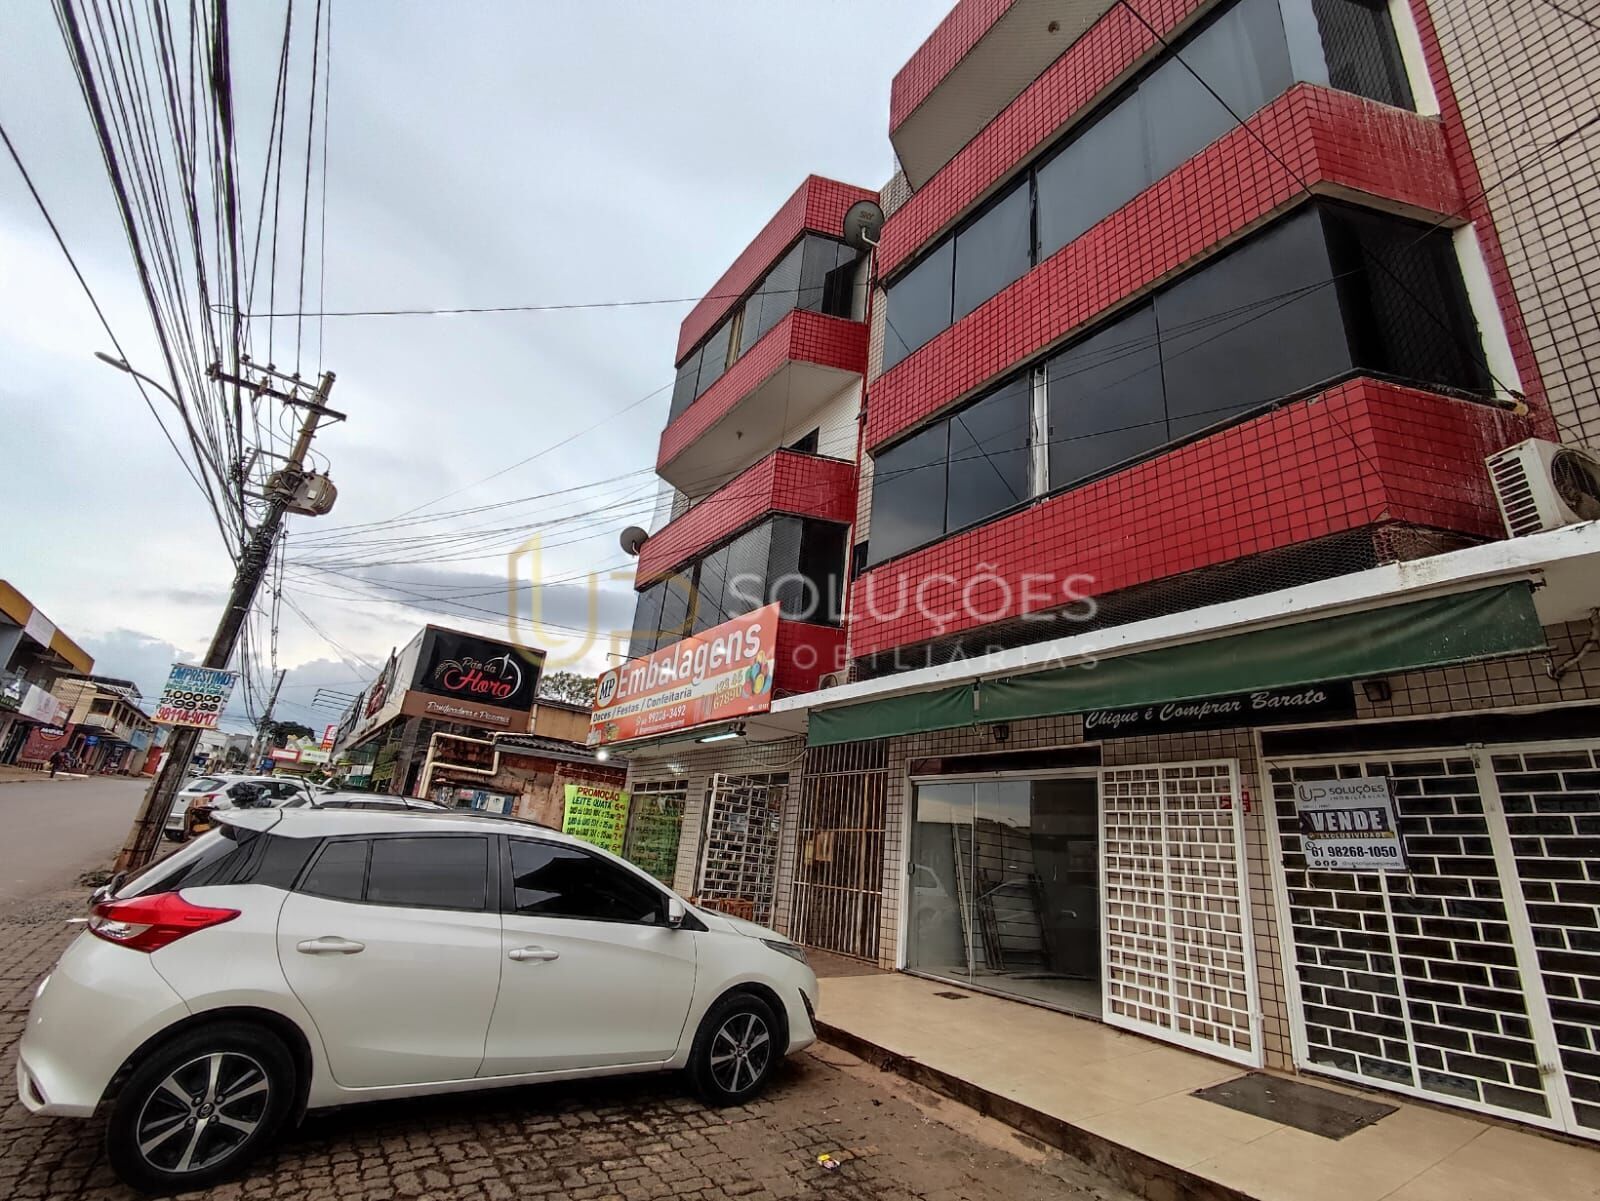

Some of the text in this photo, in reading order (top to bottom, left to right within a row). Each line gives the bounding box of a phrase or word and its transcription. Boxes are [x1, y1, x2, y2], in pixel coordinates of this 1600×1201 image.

[599, 623, 762, 700] MP Embalagens
[444, 669, 512, 698] Hora
[592, 711, 612, 722] Doces
[617, 704, 638, 716] Festas
[647, 689, 692, 709] Confeitaria
[1085, 709, 1139, 729] Chique
[1159, 699, 1242, 722] Comprar
[1249, 688, 1327, 709] Barato
[1298, 783, 1385, 802] UP SOLUÇÕES
[1310, 810, 1383, 832] VENDE
[1311, 846, 1398, 857] 61 98268-1050
